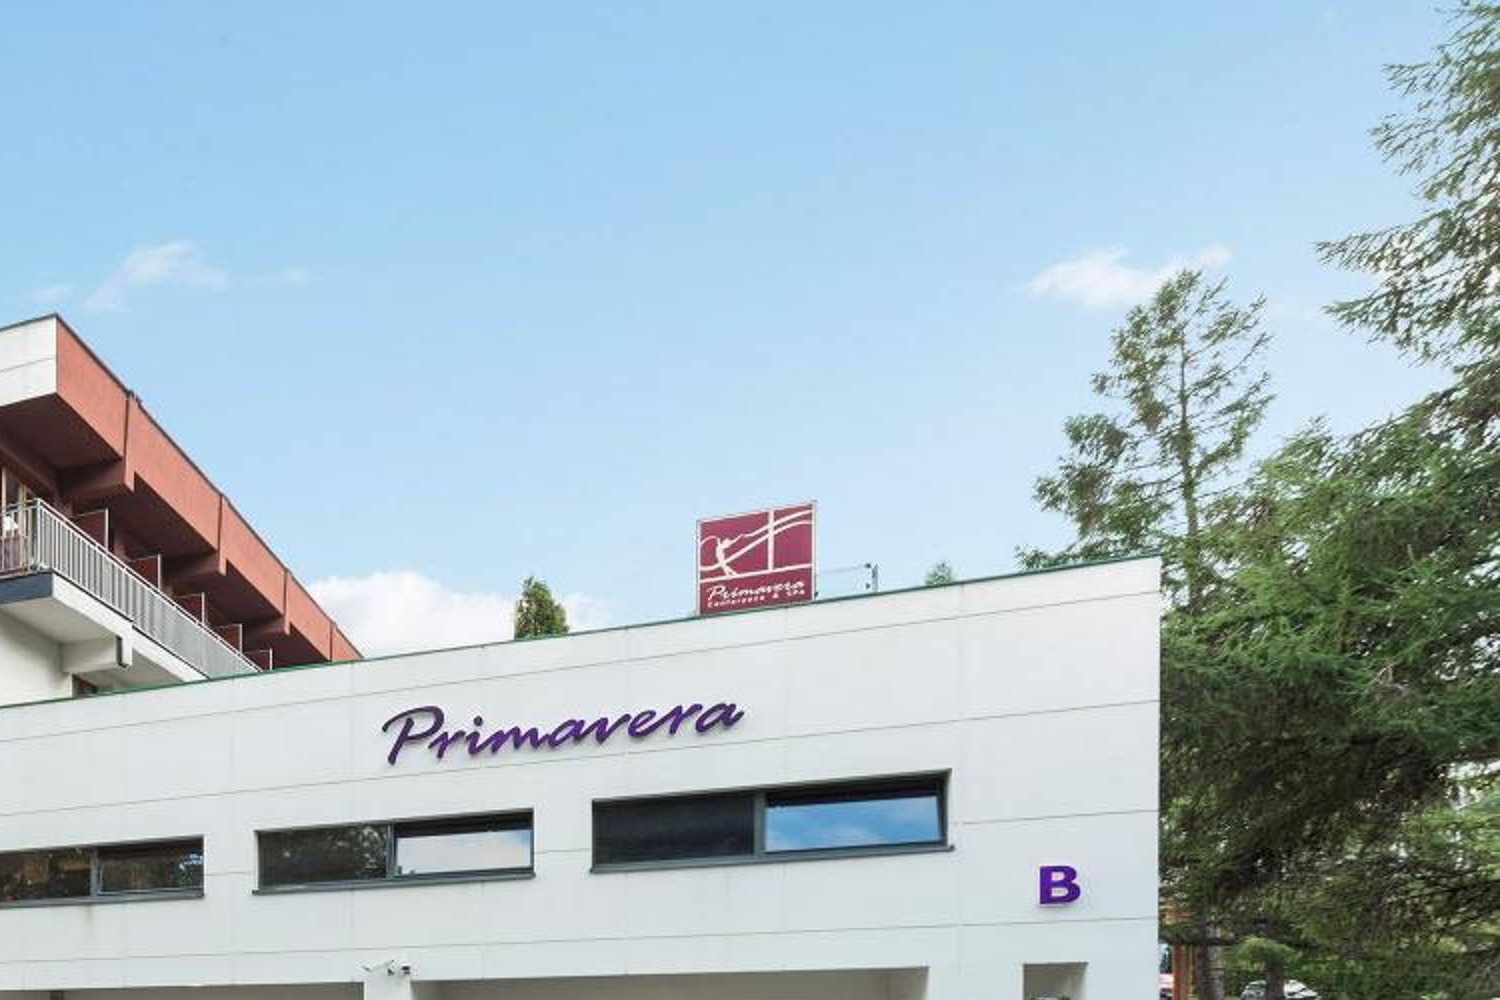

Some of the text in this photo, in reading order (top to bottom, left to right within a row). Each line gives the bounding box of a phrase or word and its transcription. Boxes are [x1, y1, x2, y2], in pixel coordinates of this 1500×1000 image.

[707, 581, 804, 601] Primavera
[382, 702, 744, 766] Primavera
[1039, 865, 1081, 905] B
